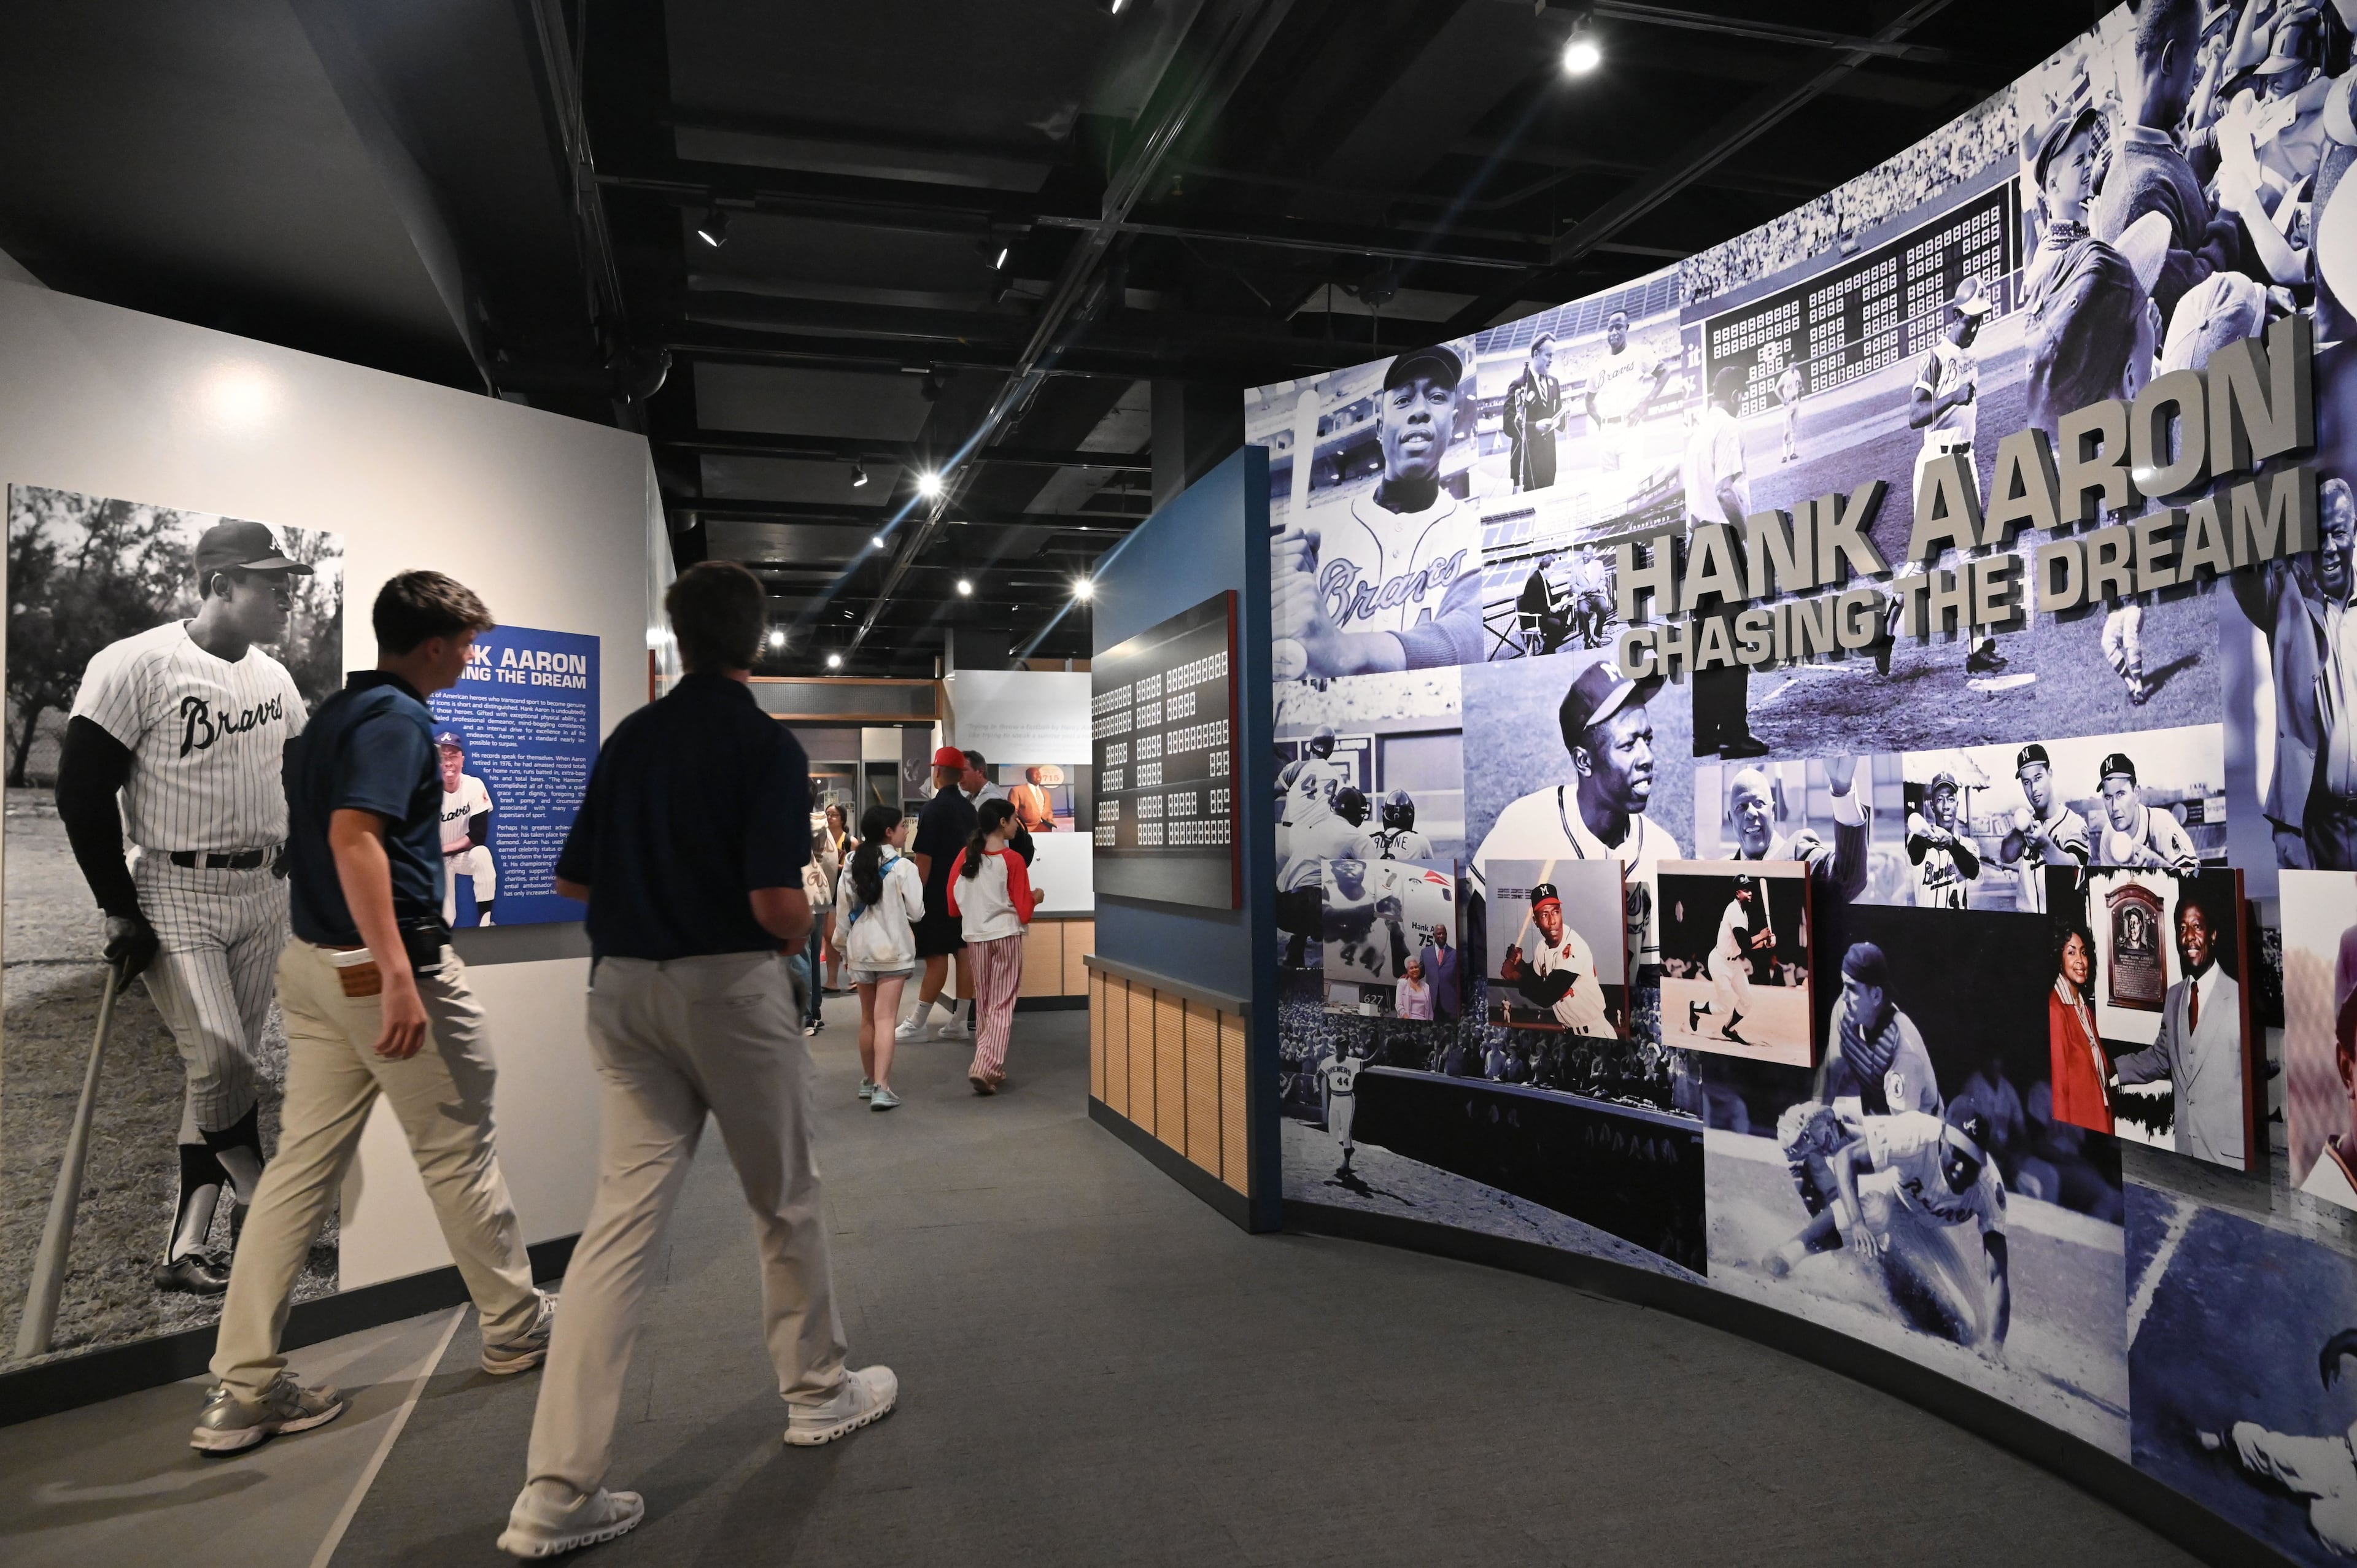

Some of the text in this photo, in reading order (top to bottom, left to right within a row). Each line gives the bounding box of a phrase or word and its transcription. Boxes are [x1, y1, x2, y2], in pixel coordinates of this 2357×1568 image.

[1598, 361, 1635, 389] Braves
[1616, 480, 1892, 622] HANK
[1906, 314, 2316, 561] AARON
[1618, 466, 2320, 684] CHASING THE DREAM
[1320, 548, 1468, 630] Braves
[500, 647, 586, 675] AARON
[495, 668, 526, 684] THE
[531, 671, 587, 689] DREAM
[180, 693, 282, 759] Braves
[440, 801, 471, 822] raves
[1412, 922, 1429, 932] Hank
[1418, 933, 1434, 947] 75
[1364, 994, 1384, 1005] 627
[1337, 1076, 1349, 1086] 44
